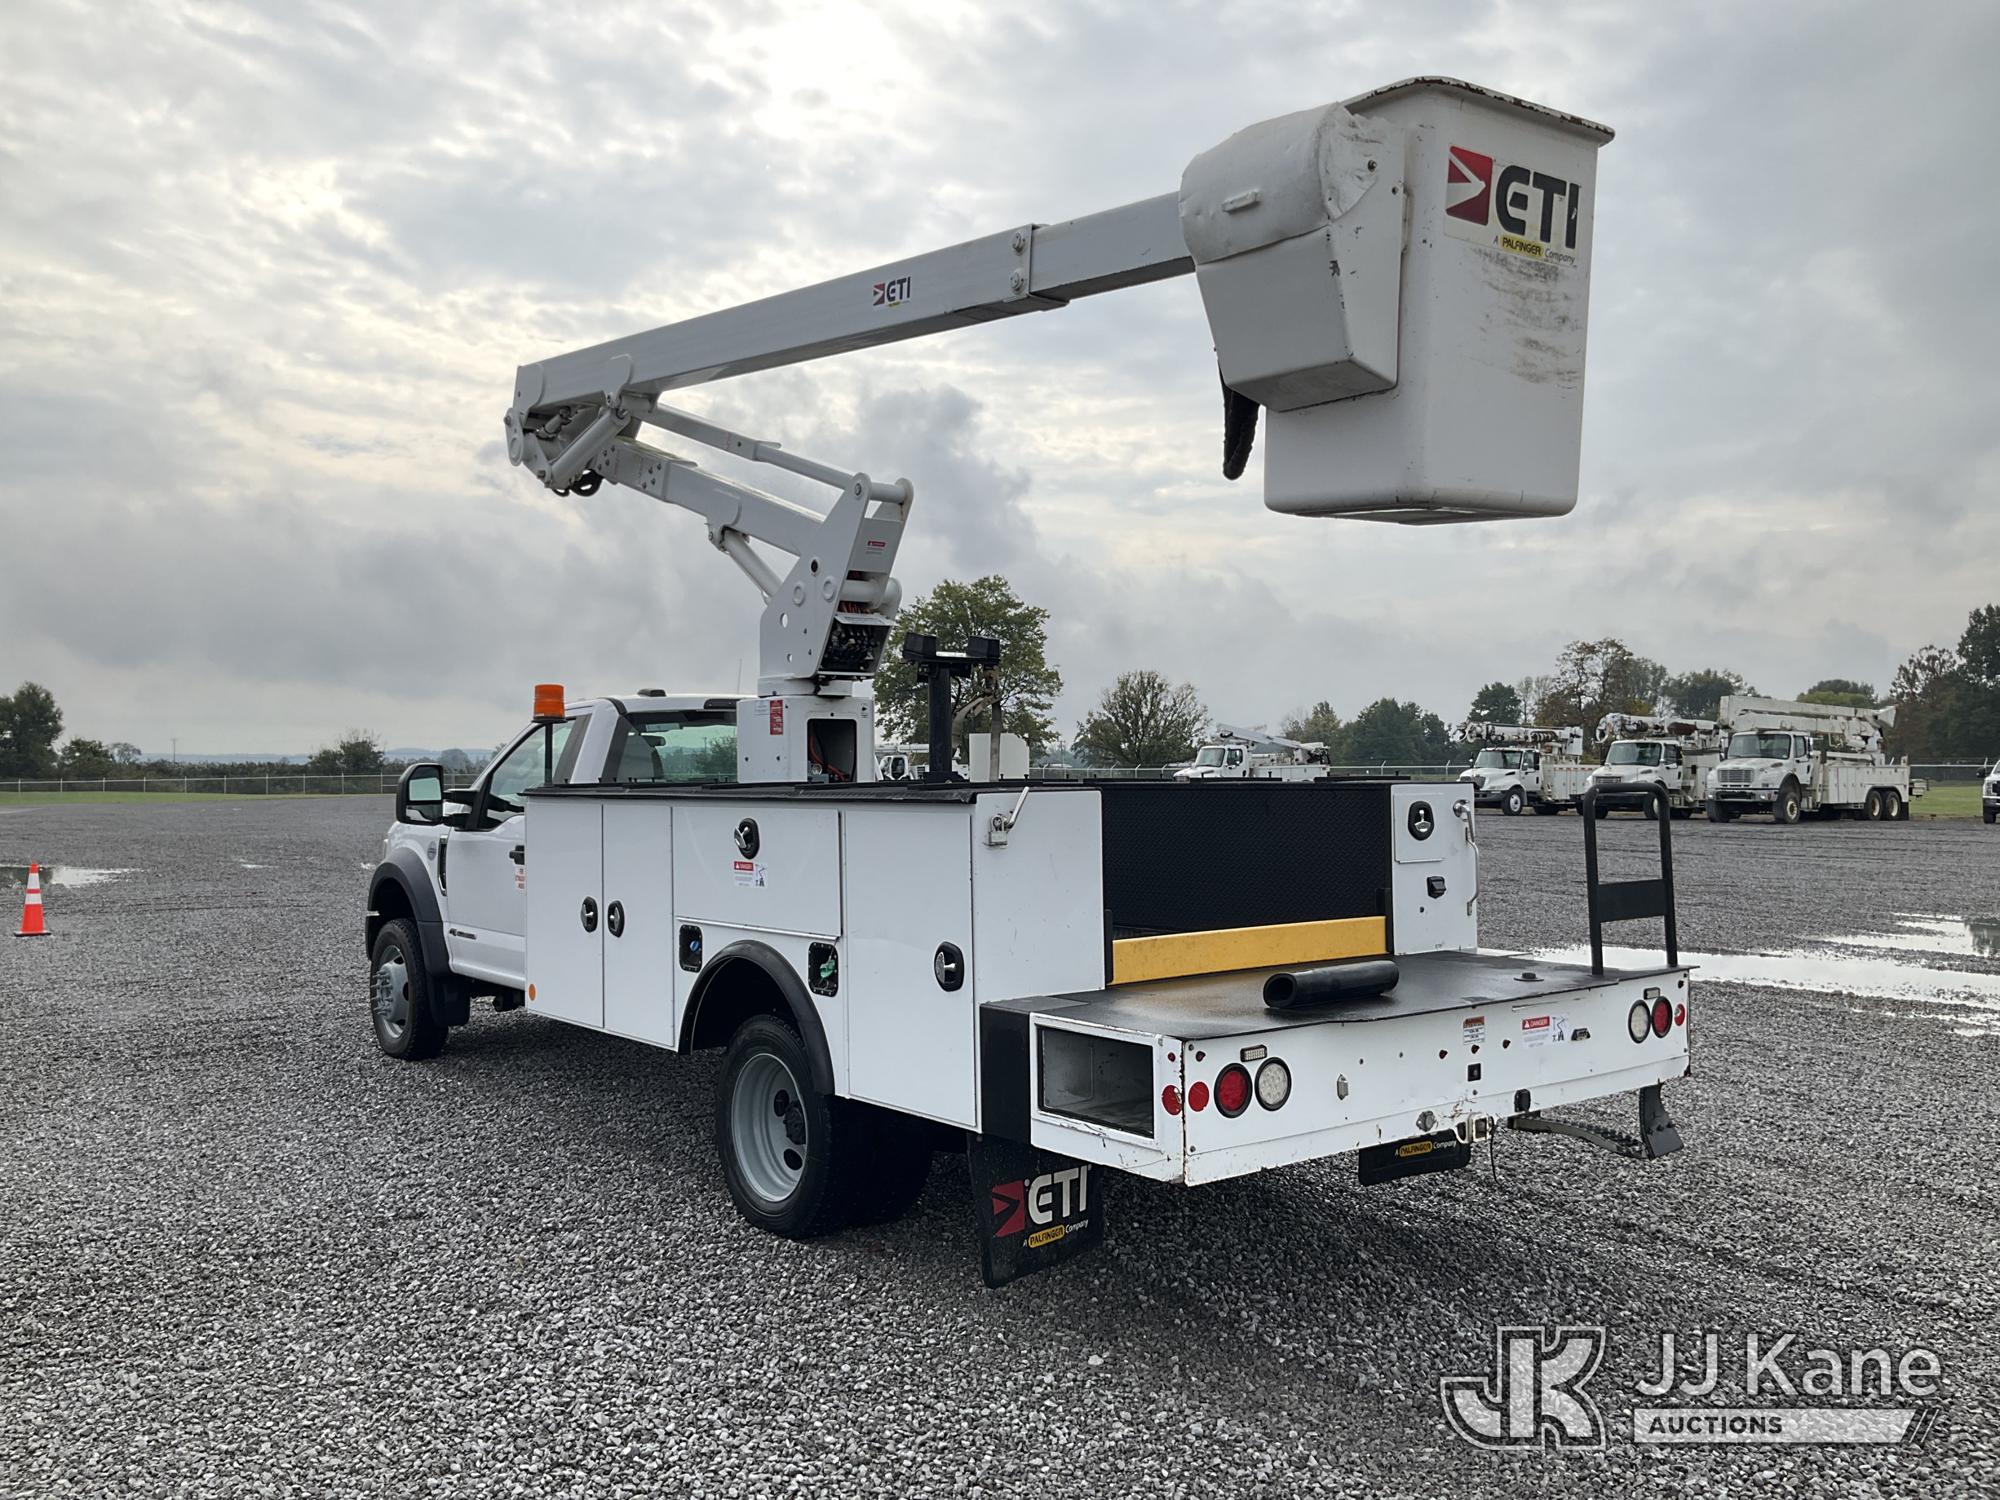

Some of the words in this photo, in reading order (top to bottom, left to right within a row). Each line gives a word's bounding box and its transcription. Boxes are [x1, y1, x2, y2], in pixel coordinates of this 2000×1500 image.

[1495, 164, 1580, 249] ETI
[1493, 236, 1499, 246] A
[1502, 237, 1542, 256] PALFINGER
[1544, 248, 1576, 265] Company
[886, 276, 911, 302] ETI
[1529, 1017, 1549, 1027] DANGER
[1028, 1165, 1088, 1225] ETI
[1065, 1219, 1089, 1234] Company
